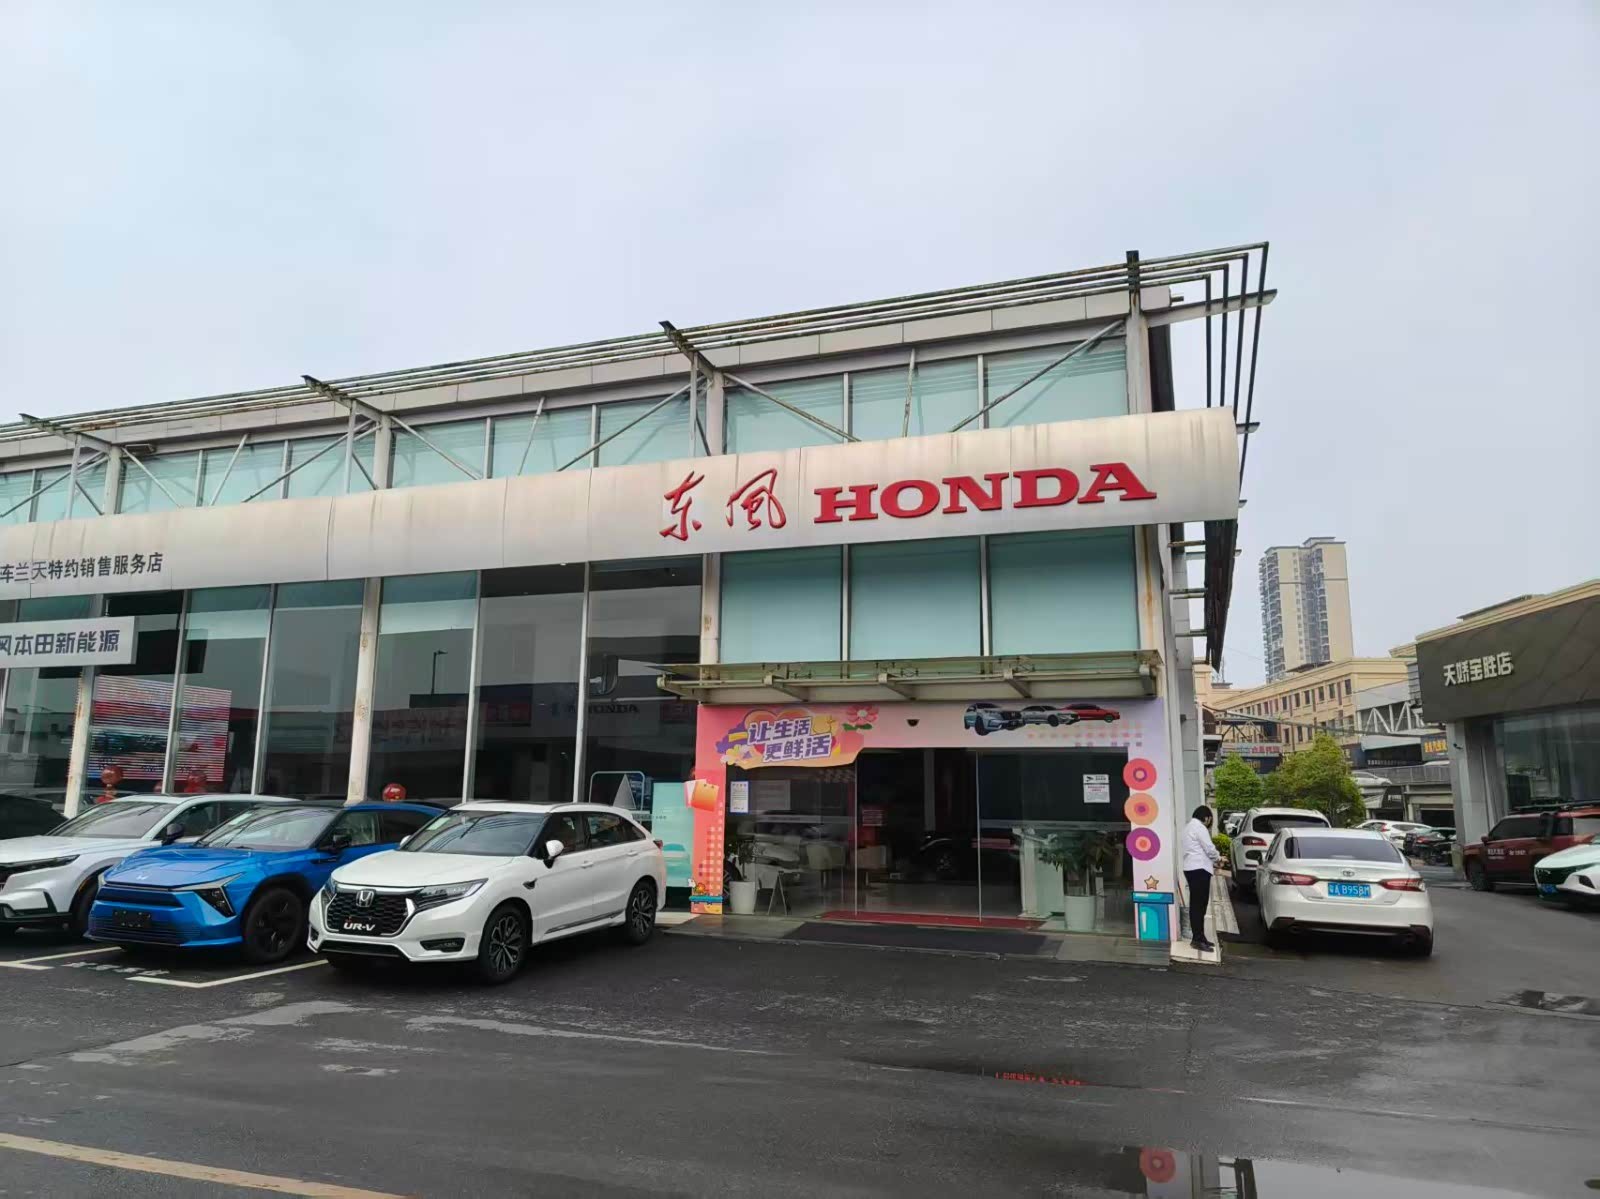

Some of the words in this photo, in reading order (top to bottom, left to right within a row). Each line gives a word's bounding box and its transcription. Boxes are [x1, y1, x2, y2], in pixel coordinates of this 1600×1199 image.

[814, 462, 1156, 523] HONDA
[746, 718, 812, 743] 让生活
[762, 734, 832, 761] 更鲜活
[343, 922, 376, 931] UR-V
